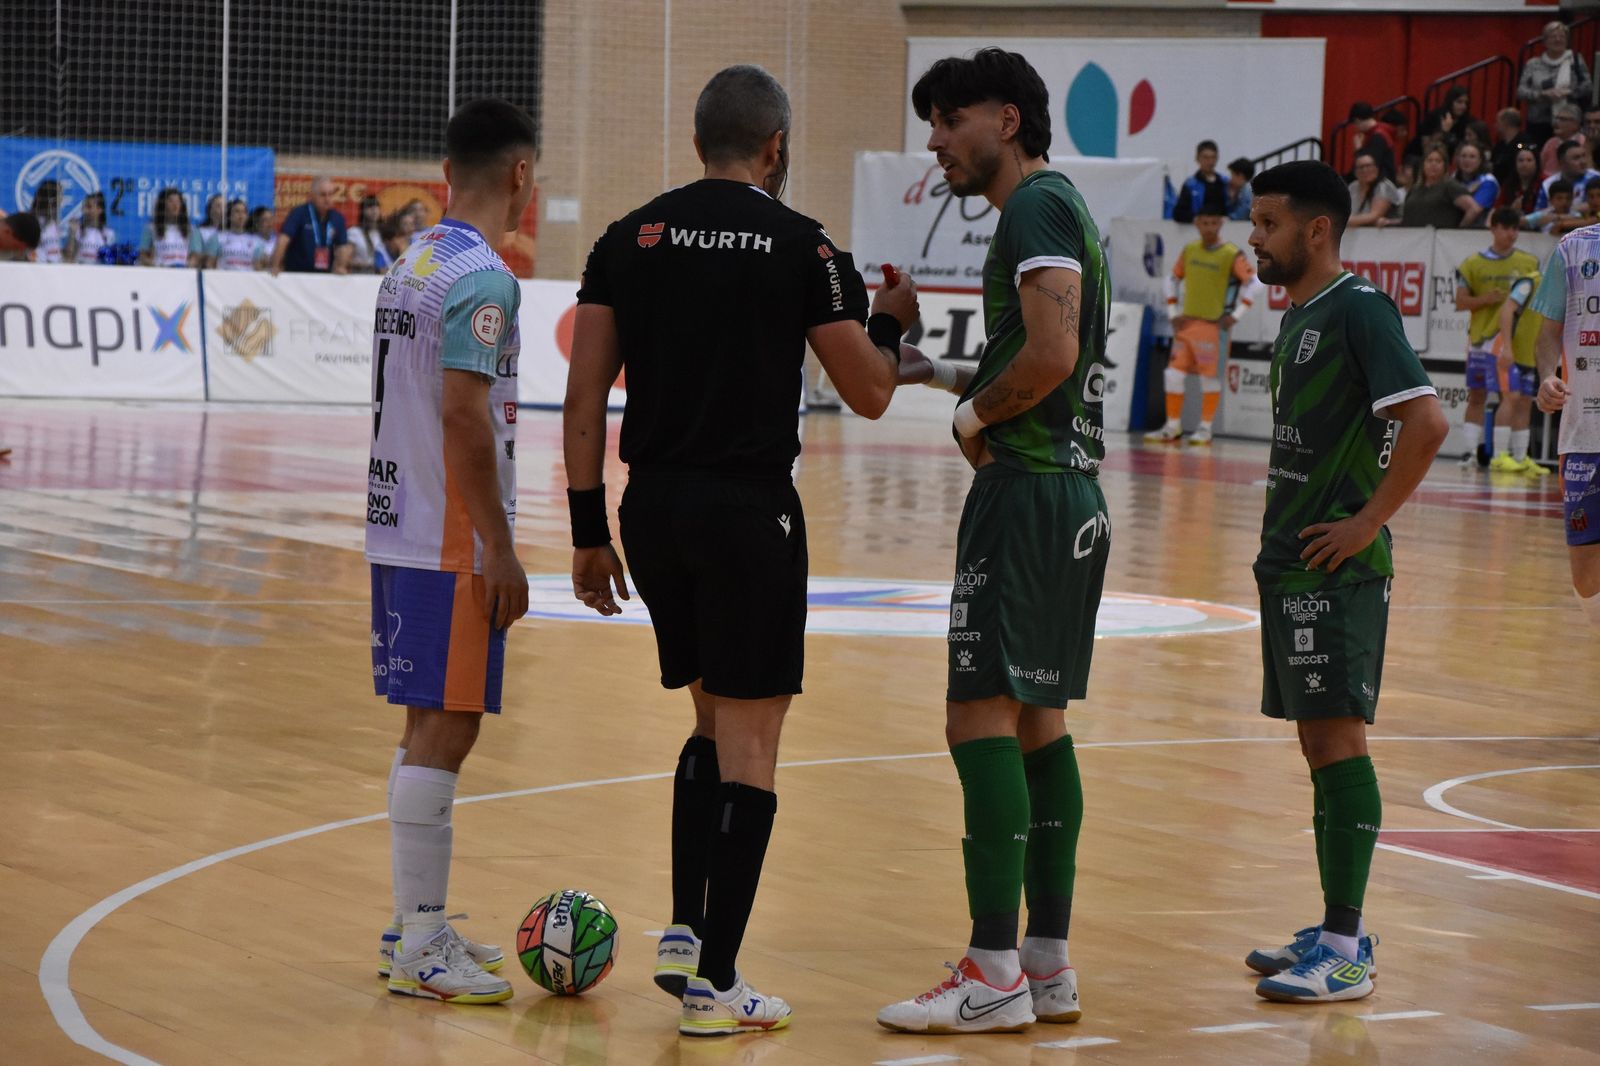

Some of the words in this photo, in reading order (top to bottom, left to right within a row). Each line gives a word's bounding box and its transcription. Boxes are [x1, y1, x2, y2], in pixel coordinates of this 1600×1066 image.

[670, 227, 773, 254] WÜRTH
[826, 259, 844, 312] WÜRTH
[1009, 664, 1061, 685] Silvergold
